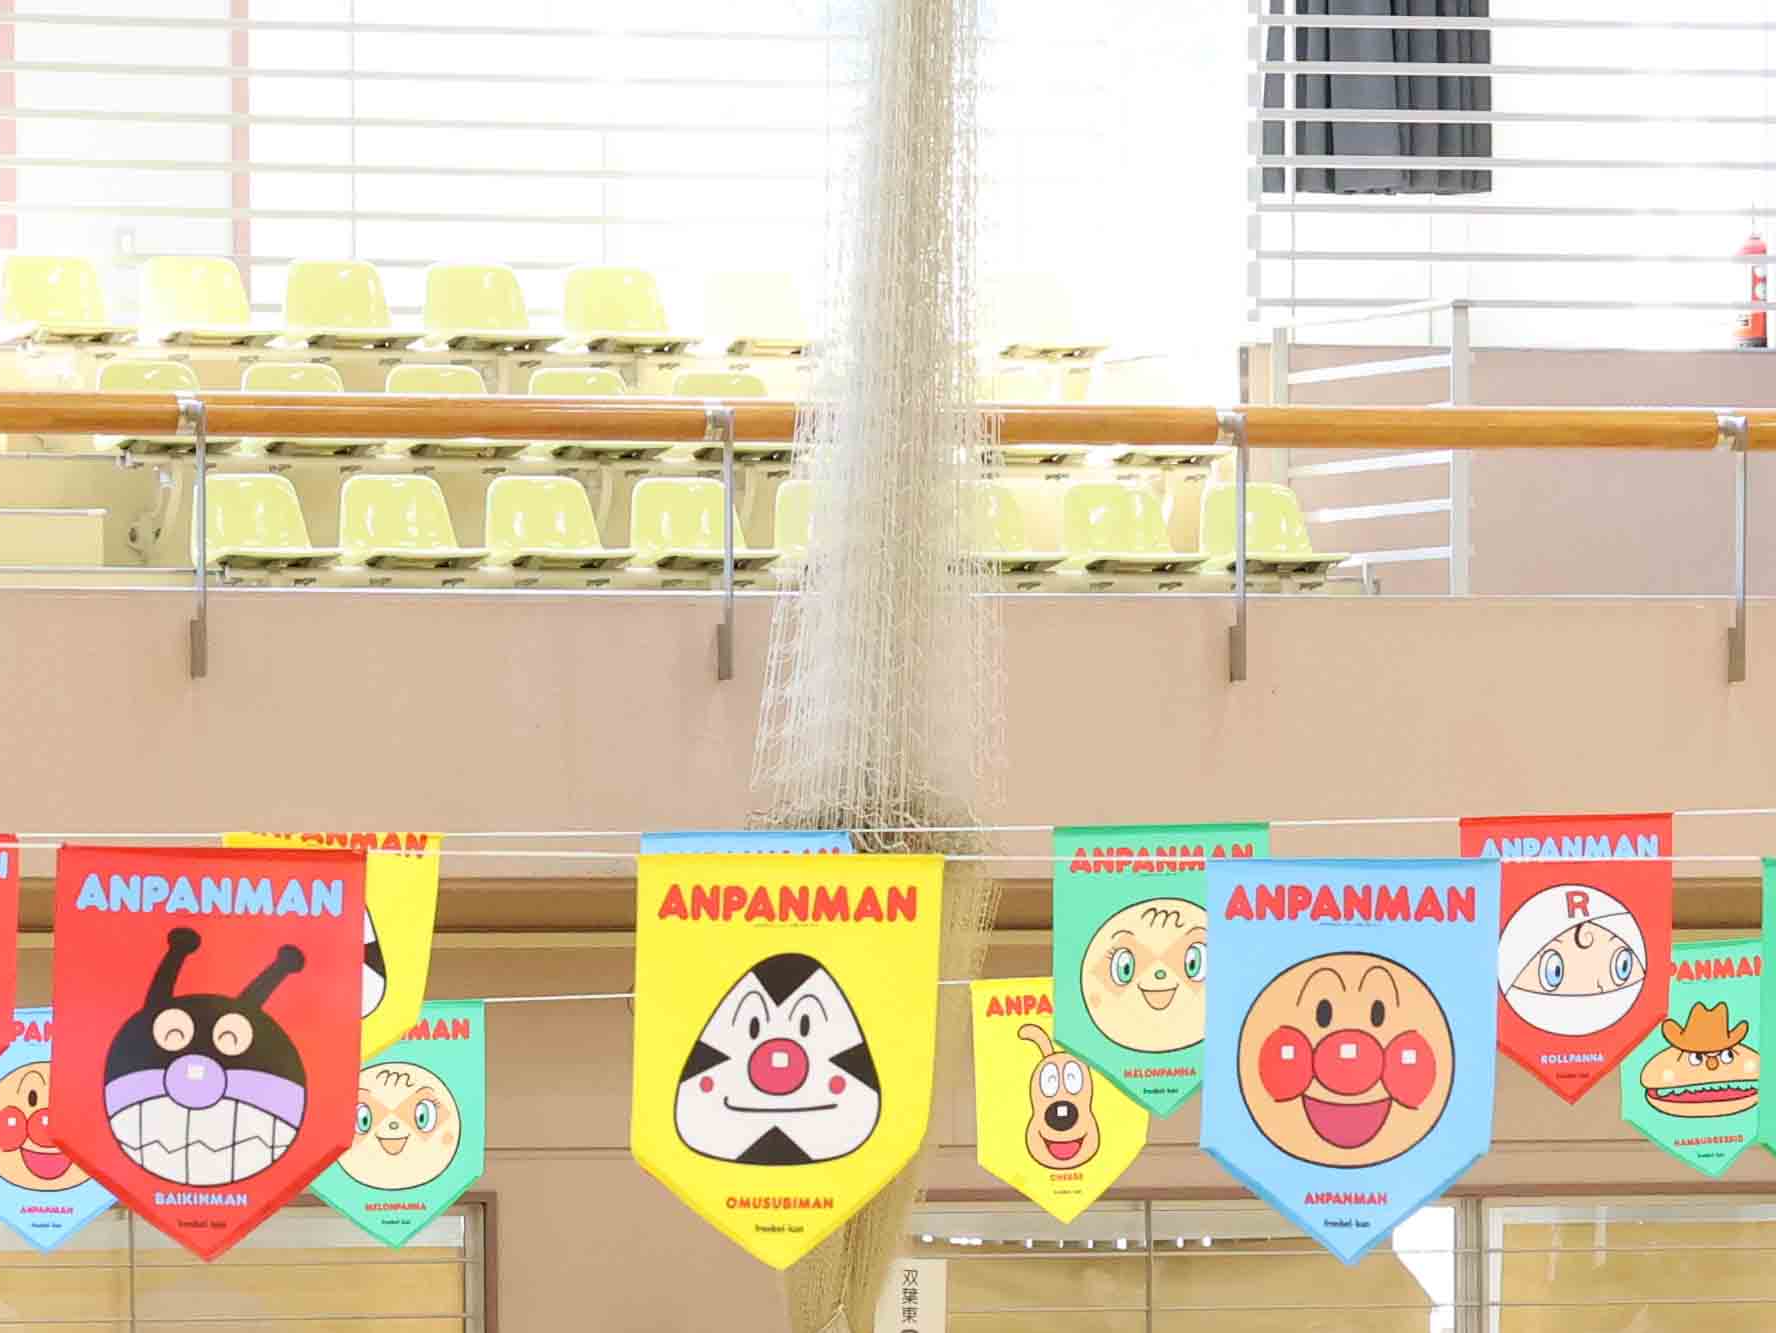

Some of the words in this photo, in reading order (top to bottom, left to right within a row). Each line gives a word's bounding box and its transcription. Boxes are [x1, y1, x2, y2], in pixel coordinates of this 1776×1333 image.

[1480, 834, 1658, 862] ANPANMAN
[75, 873, 344, 917] ANPANMAN
[657, 883, 918, 923] ANPANMAN
[1225, 884, 1476, 922] ANPANMAN
[986, 994, 1053, 1019] ANPA
[154, 1191, 248, 1209] BAIKINMAN
[726, 1196, 834, 1210] OMUSUBIMAN
[1303, 1191, 1388, 1206] ANPANMAN
[901, 1268, 920, 1324] 双葉東
